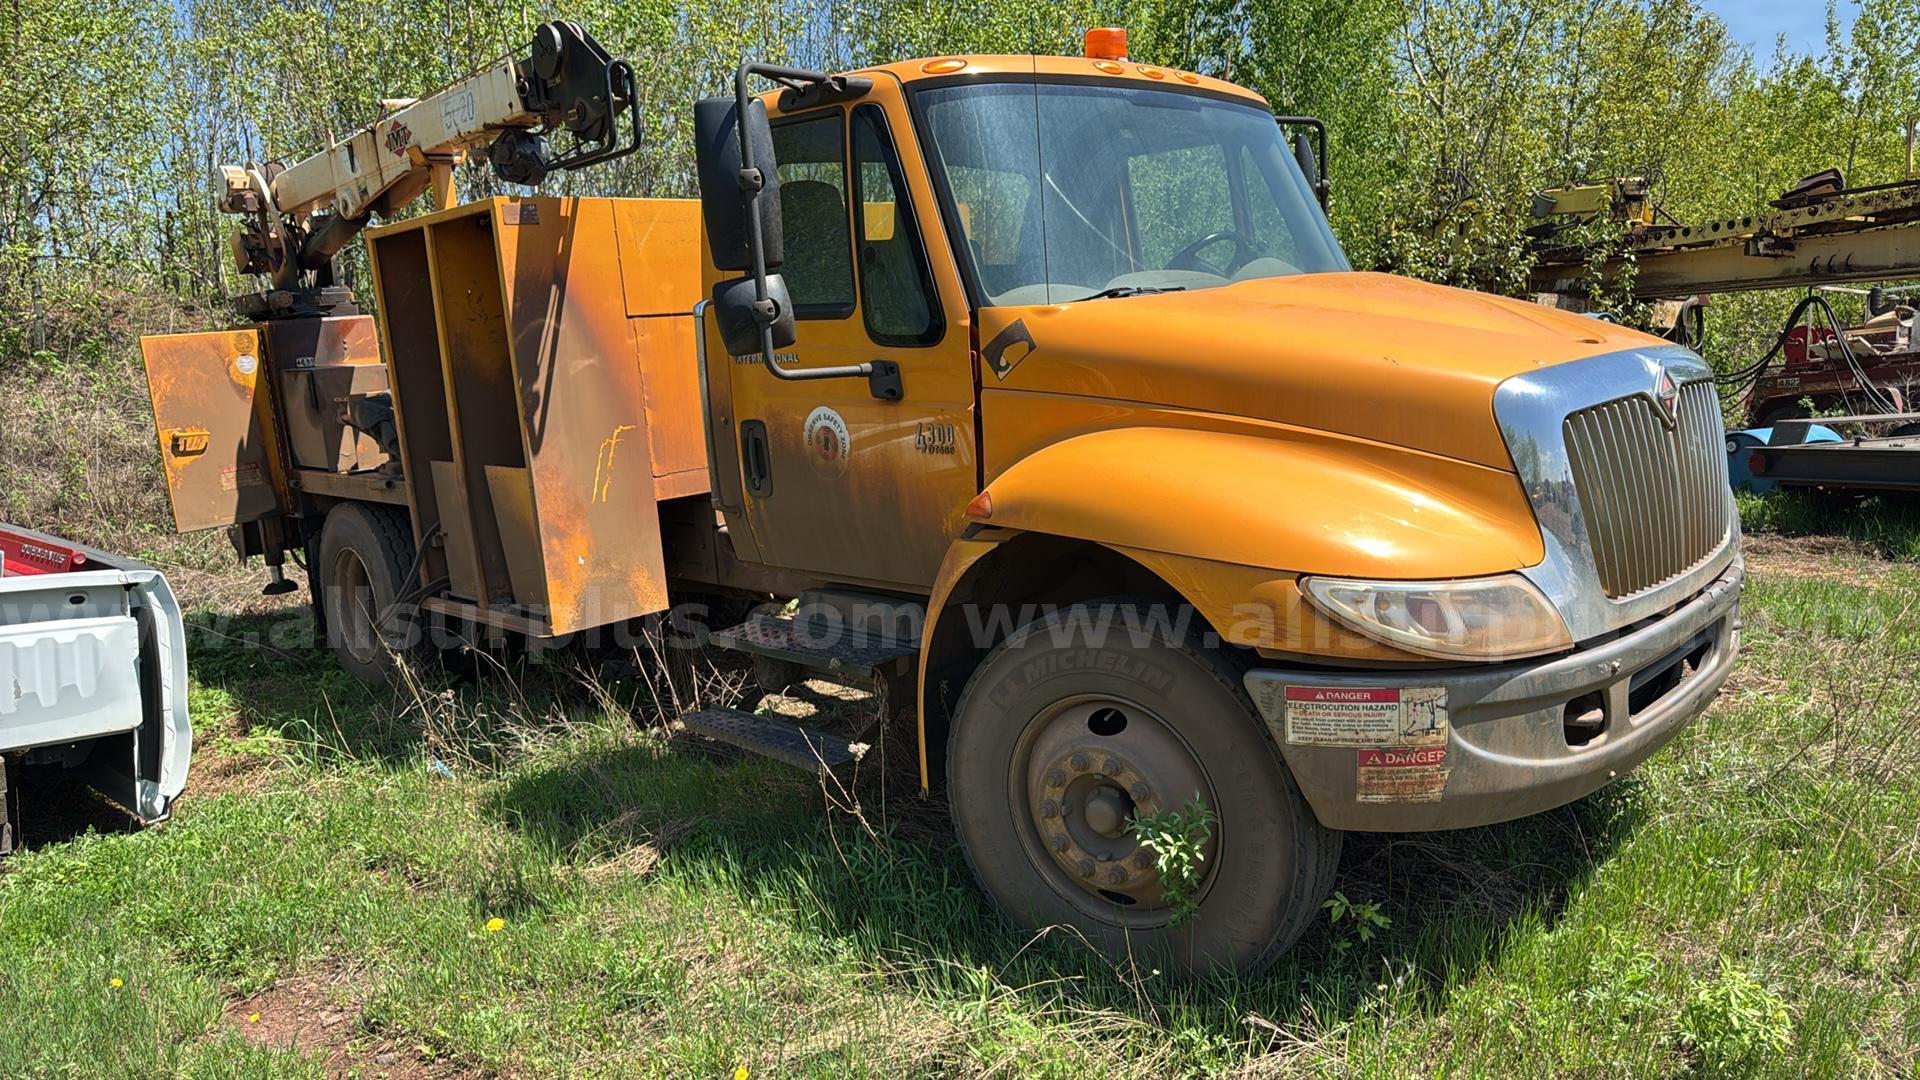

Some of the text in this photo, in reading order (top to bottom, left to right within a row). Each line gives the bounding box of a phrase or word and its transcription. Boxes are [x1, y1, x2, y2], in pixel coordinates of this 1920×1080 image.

[386, 122, 410, 153] IMT
[733, 352, 799, 365] INTERNONAL
[807, 413, 823, 447] OBSERVE
[823, 413, 844, 434] SAFETY
[915, 422, 956, 453] 4300
[1023, 650, 1175, 690] MICHELIN
[1288, 703, 1398, 712] ELECTROCUTION HAZARD
[1326, 692, 1371, 700] DANGER
